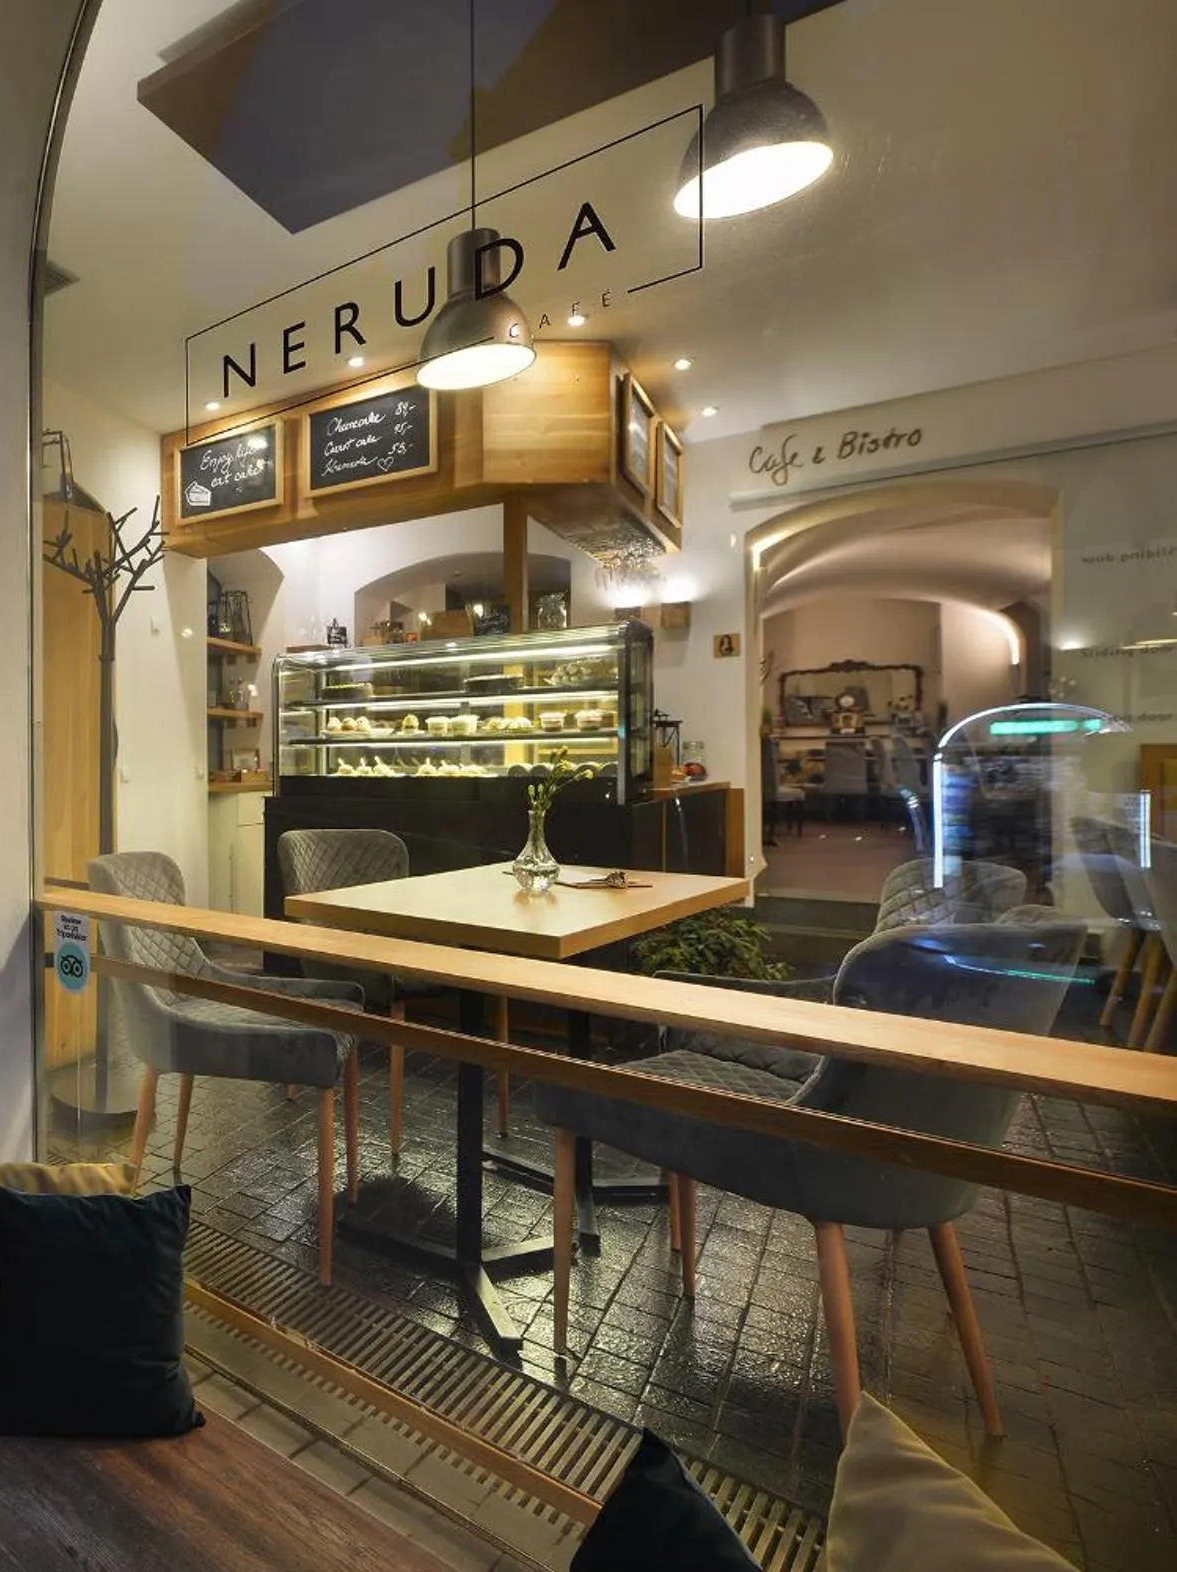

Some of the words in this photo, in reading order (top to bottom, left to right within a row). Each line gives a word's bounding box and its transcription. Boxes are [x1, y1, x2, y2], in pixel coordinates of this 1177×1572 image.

[223, 202, 616, 398] NERUDA
[509, 289, 611, 338] CAFÉ
[837, 427, 923, 460] Bistro
